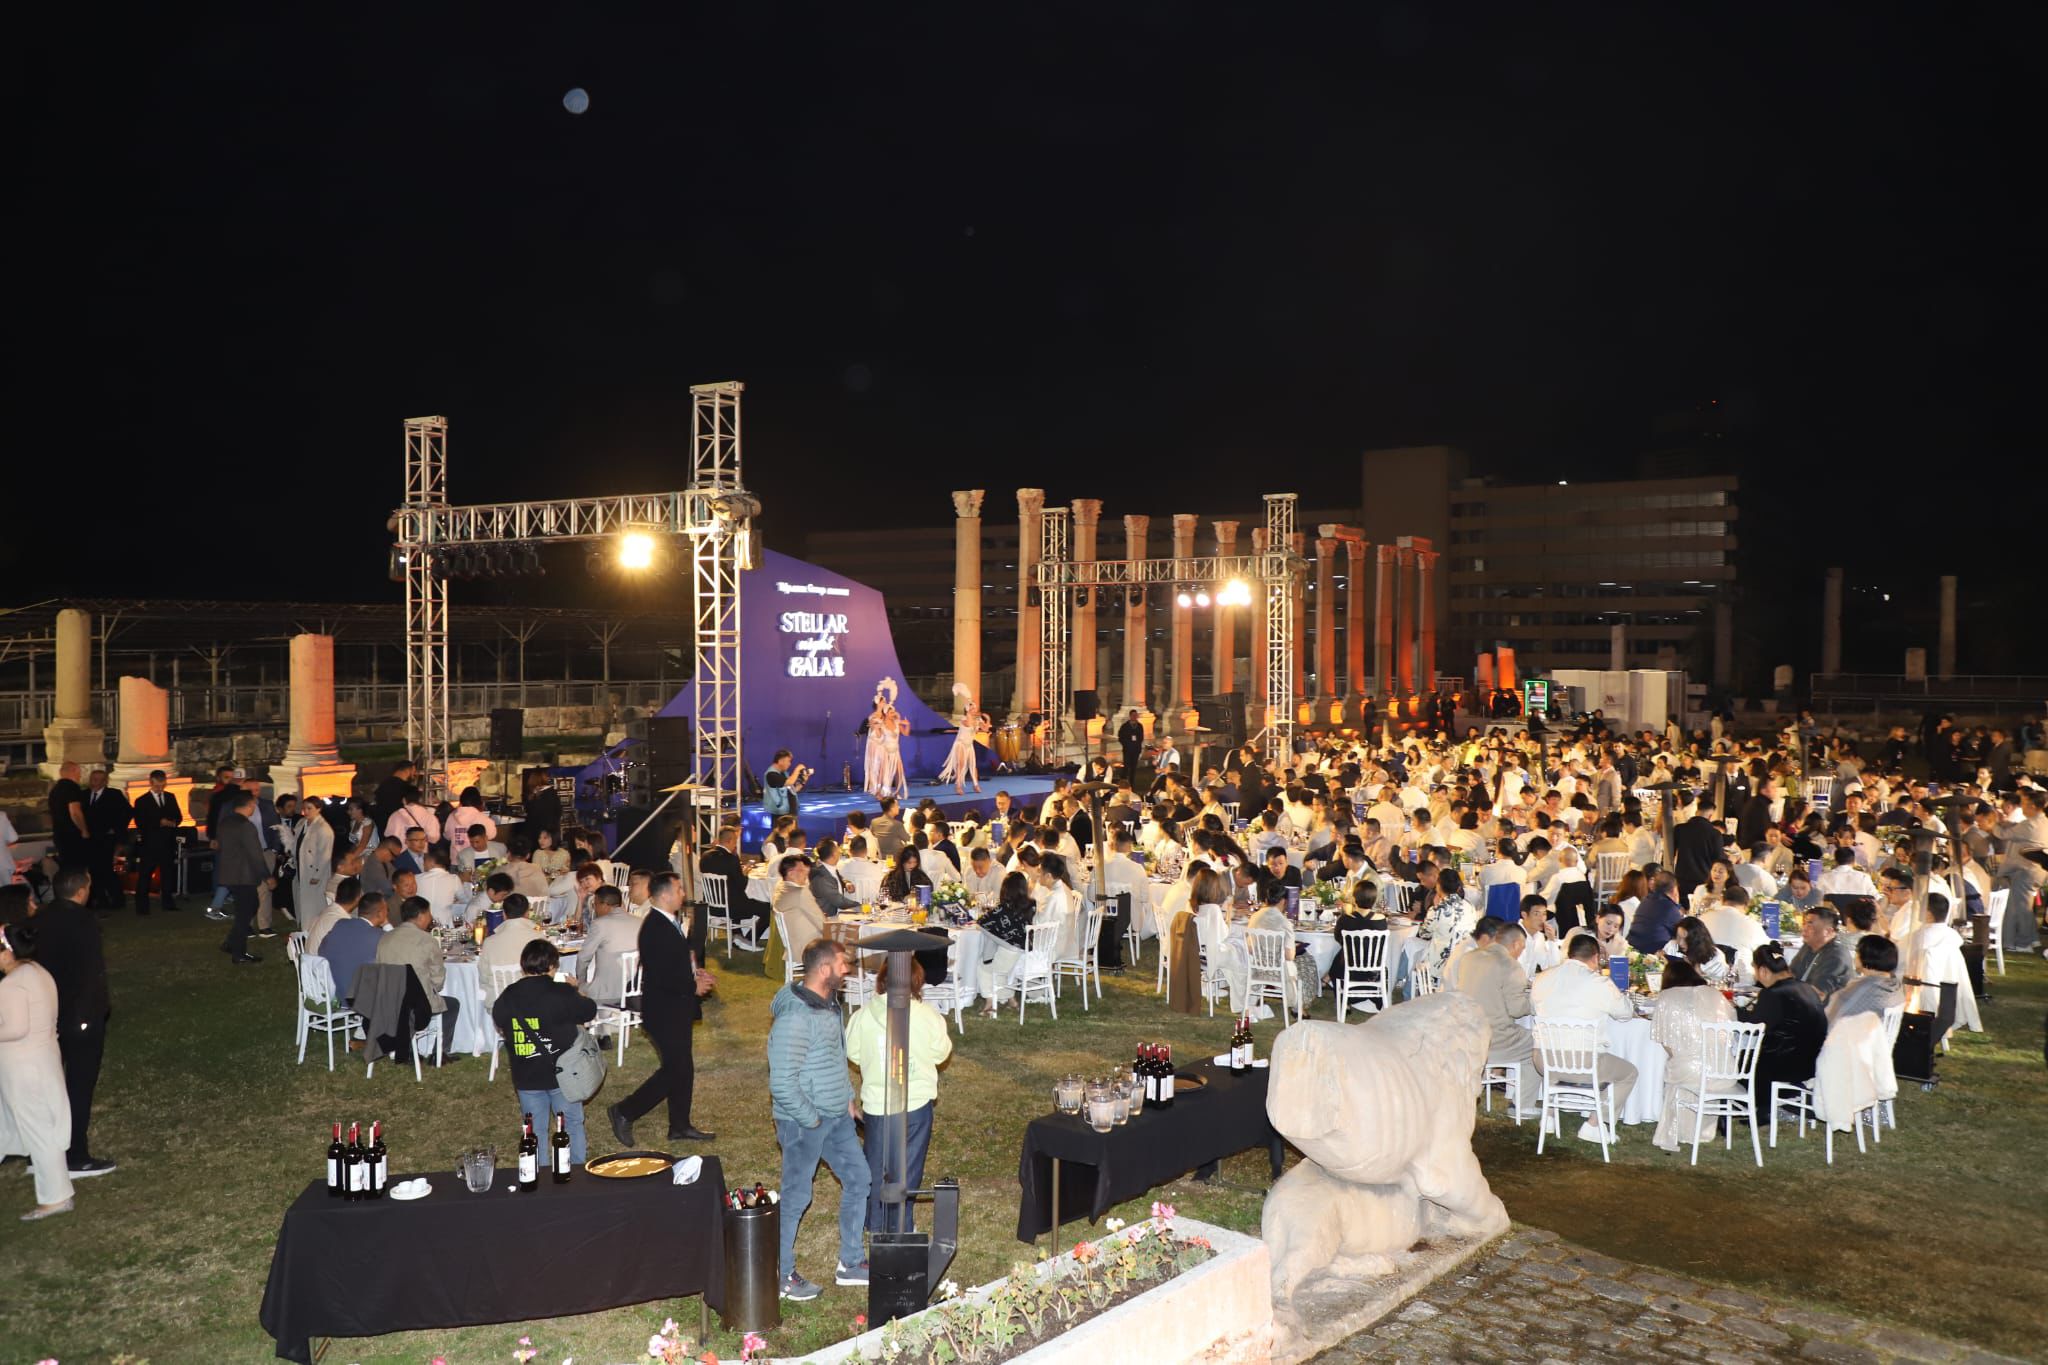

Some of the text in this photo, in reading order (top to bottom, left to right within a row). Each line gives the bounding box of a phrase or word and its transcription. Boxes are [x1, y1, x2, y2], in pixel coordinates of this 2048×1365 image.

[781, 611, 849, 633] STELLAR
[513, 1031, 525, 1043] TO
[514, 1043, 537, 1056] TRIP
